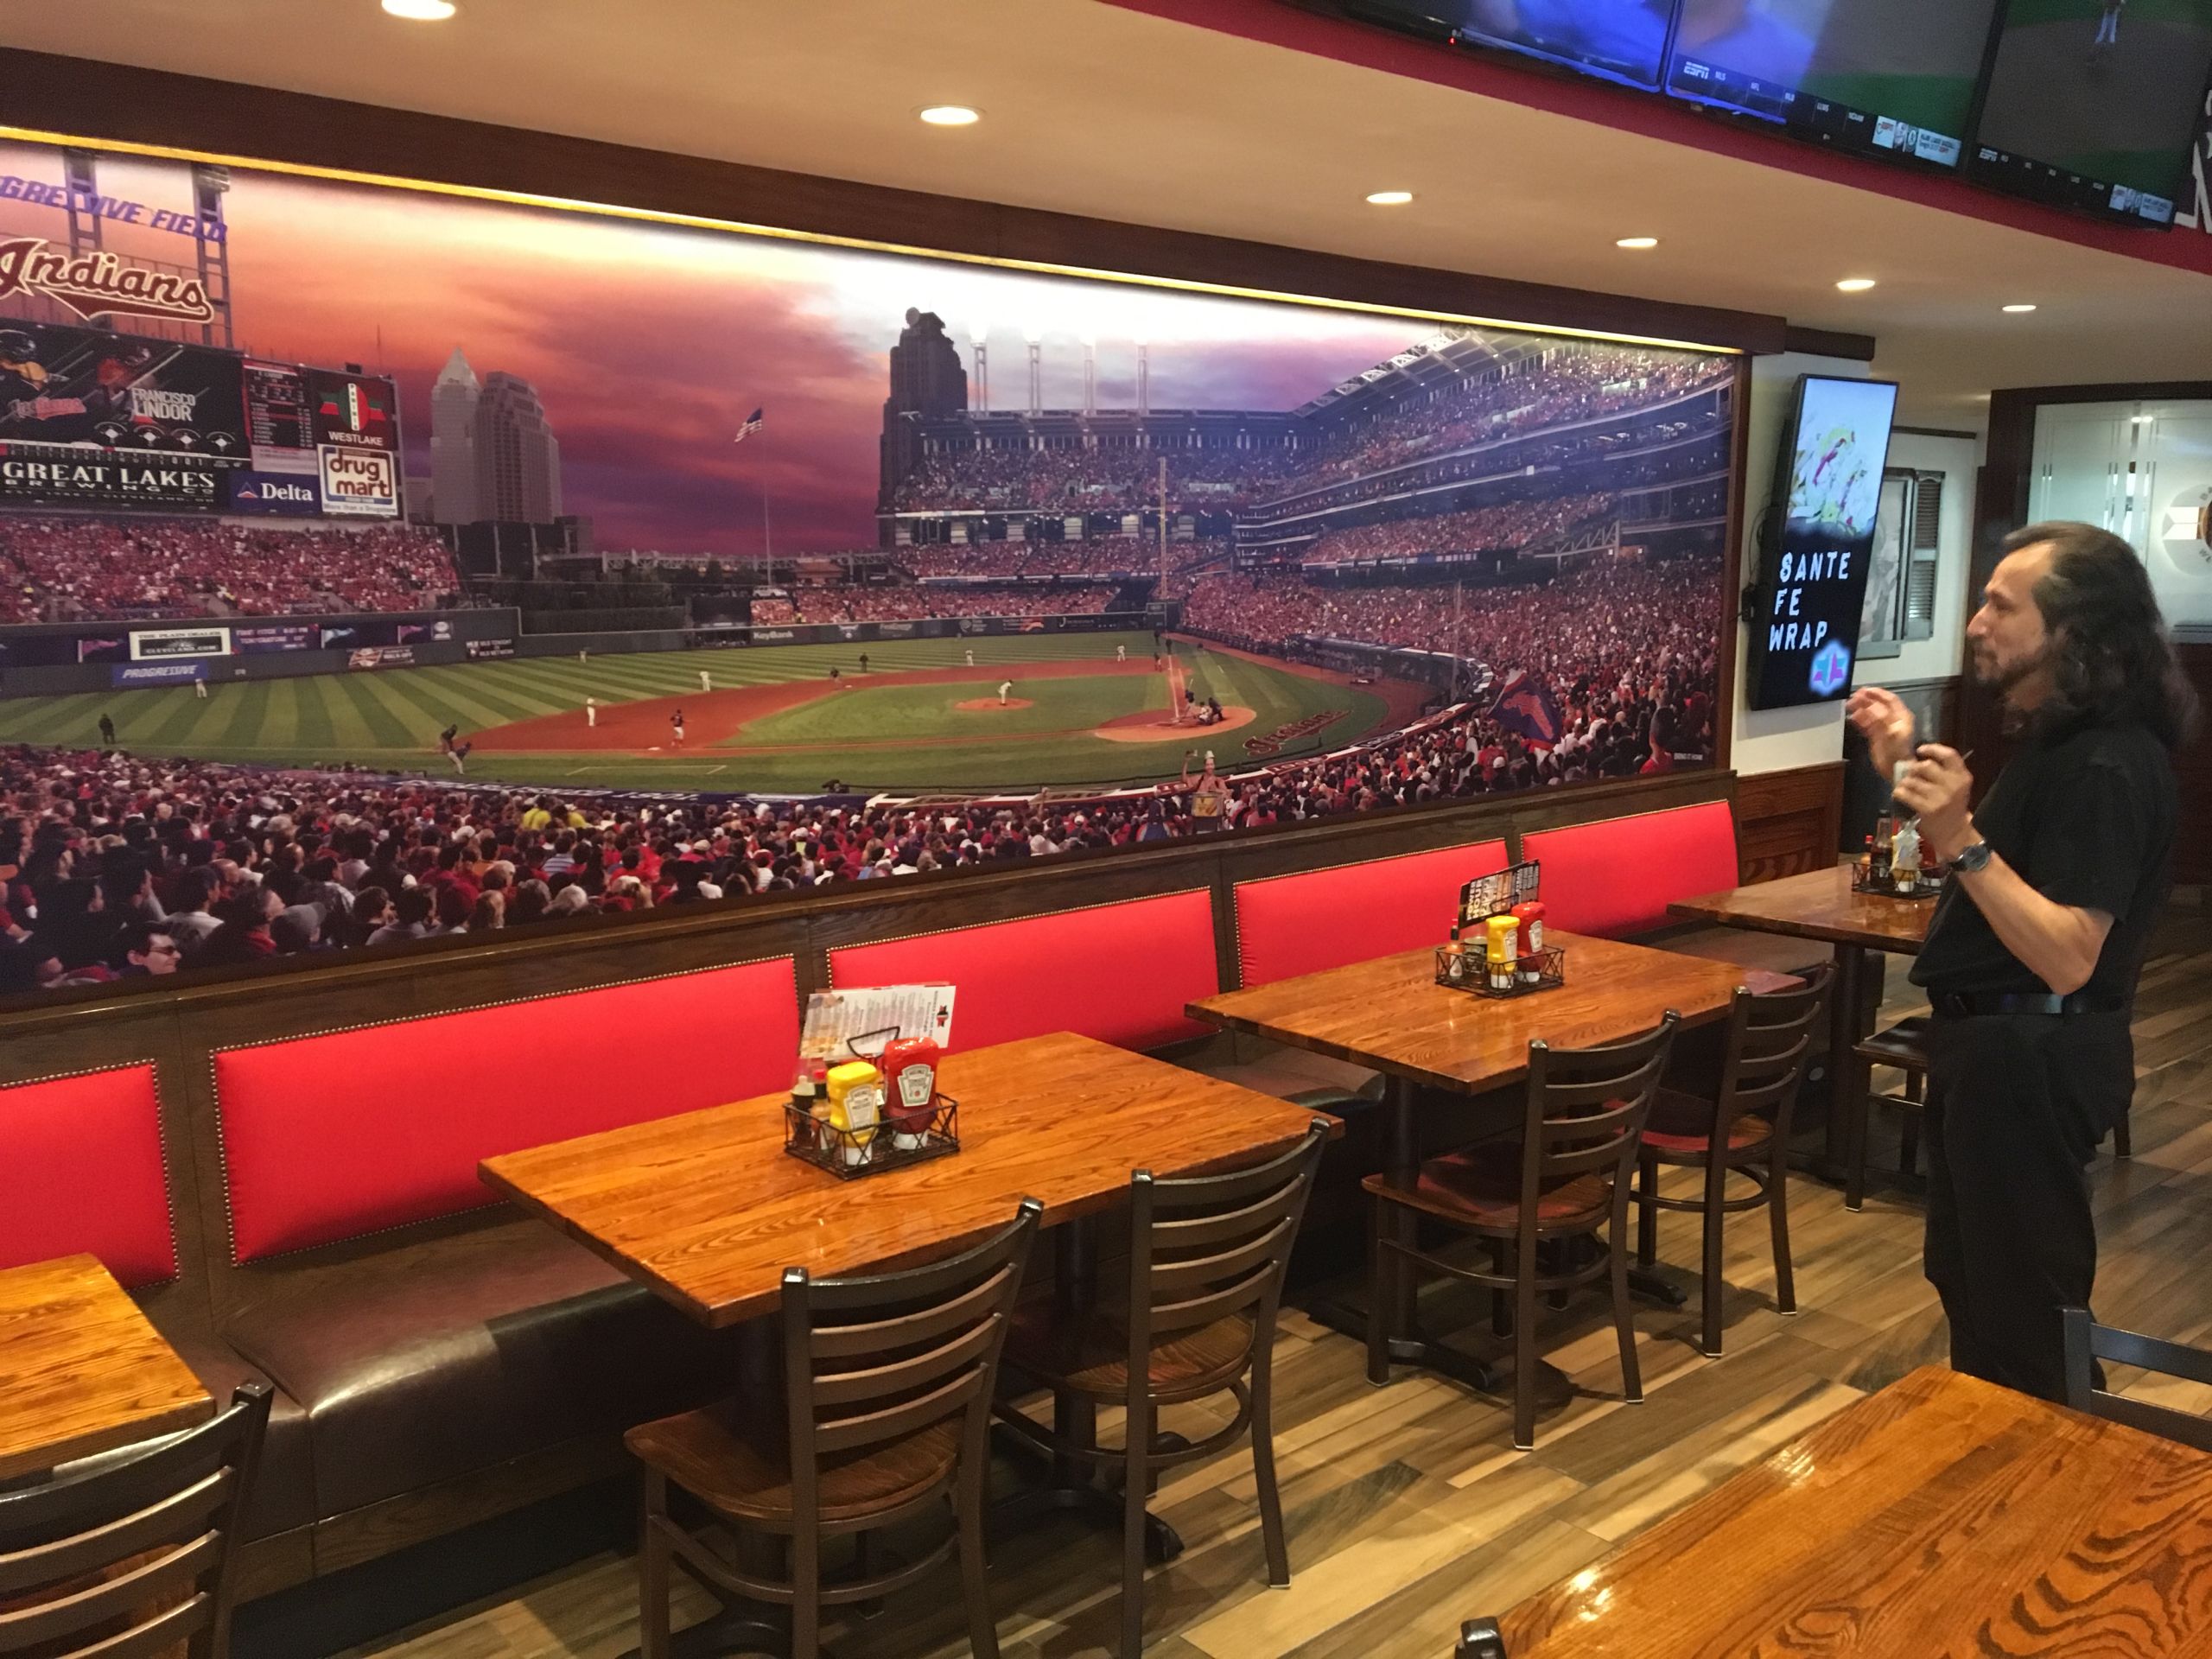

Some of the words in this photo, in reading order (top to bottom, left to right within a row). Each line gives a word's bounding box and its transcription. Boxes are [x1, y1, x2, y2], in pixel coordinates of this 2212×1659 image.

[0, 238, 213, 323] Indians
[132, 389, 196, 406] FRANCISCO
[133, 401, 194, 422] LINDOR
[328, 431, 384, 446] WESTLAKE
[3, 461, 110, 482] GREAT
[119, 468, 215, 487] LAKES
[330, 448, 380, 481] drug
[260, 482, 314, 501] Delta
[336, 480, 393, 498] mart
[1780, 551, 1852, 582] SANTE
[1775, 588, 1802, 616] FE
[753, 631, 794, 640] KeyBank
[1769, 620, 1827, 652] WRAP
[123, 664, 198, 679] PROGRESSIVE
[1466, 880, 1477, 921] POWER
[1472, 878, 1483, 918] HOUR
